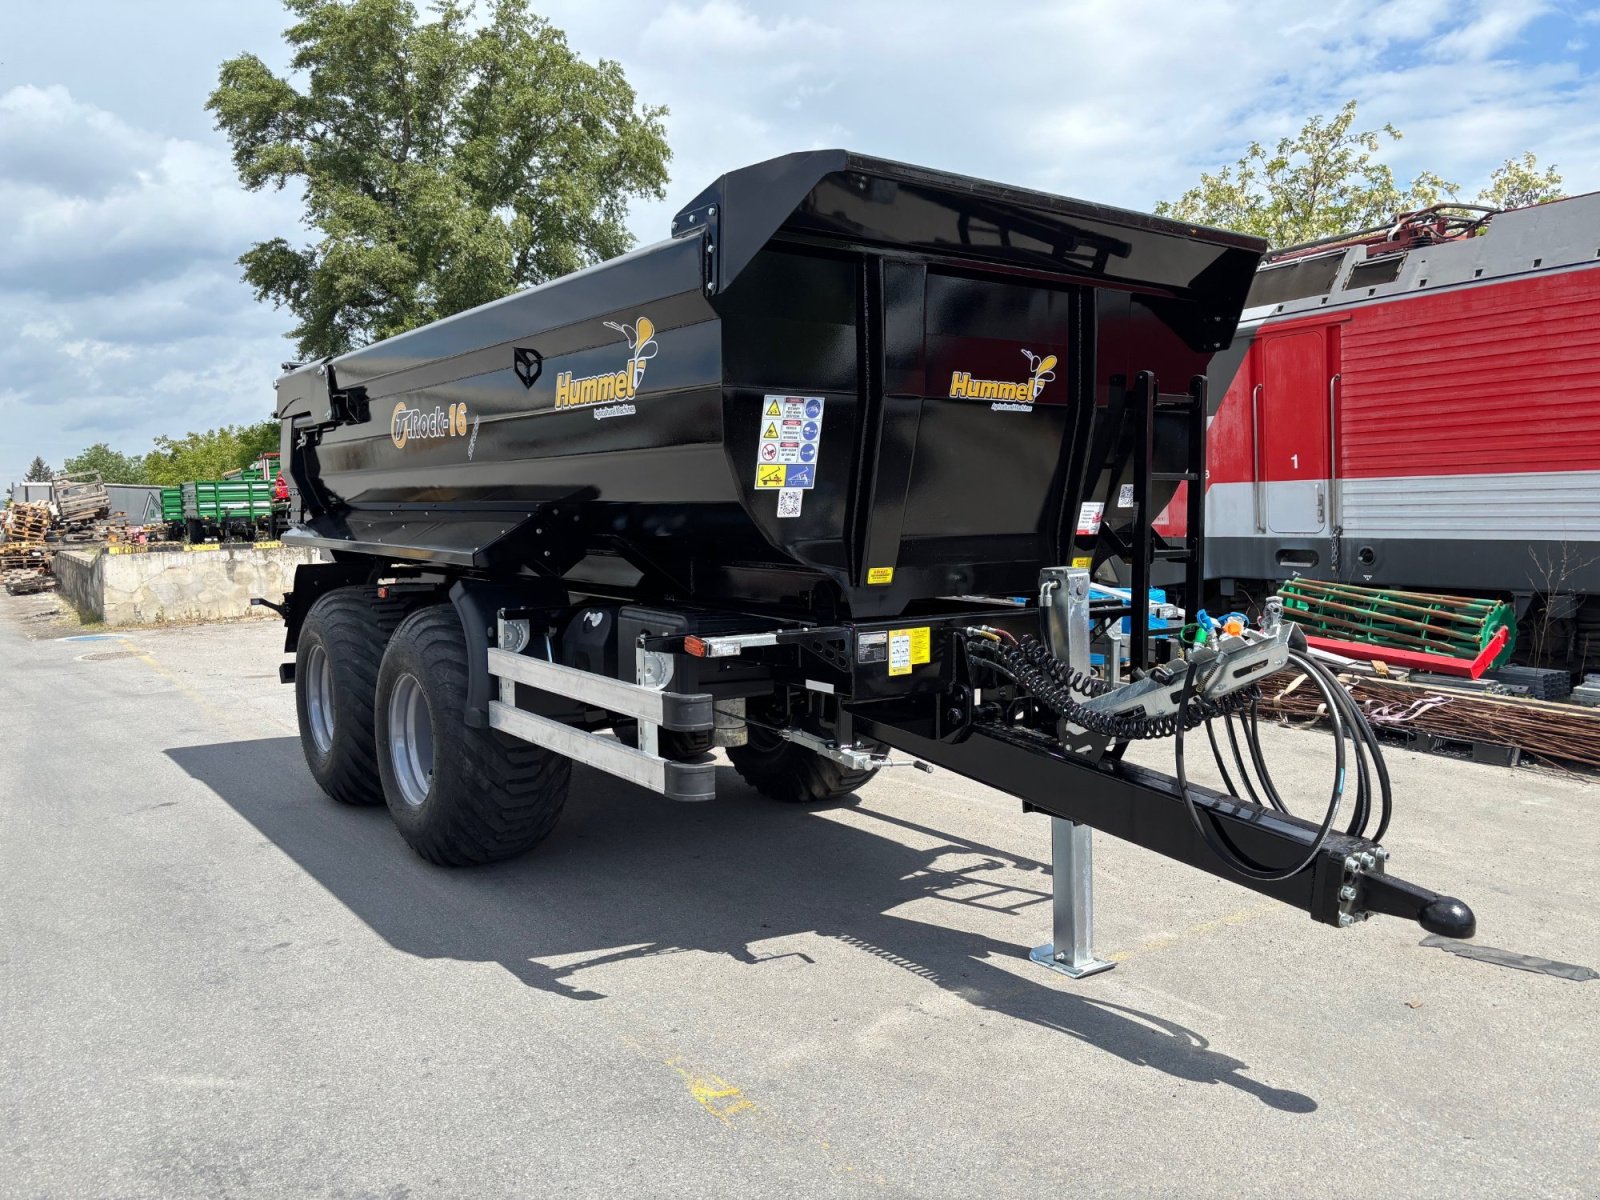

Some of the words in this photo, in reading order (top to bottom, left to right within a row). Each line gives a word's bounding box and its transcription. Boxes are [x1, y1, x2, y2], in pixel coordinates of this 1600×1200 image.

[555, 359, 636, 410] Hummel
[950, 371, 1035, 403] Hummel
[1291, 453, 1299, 469] 1
